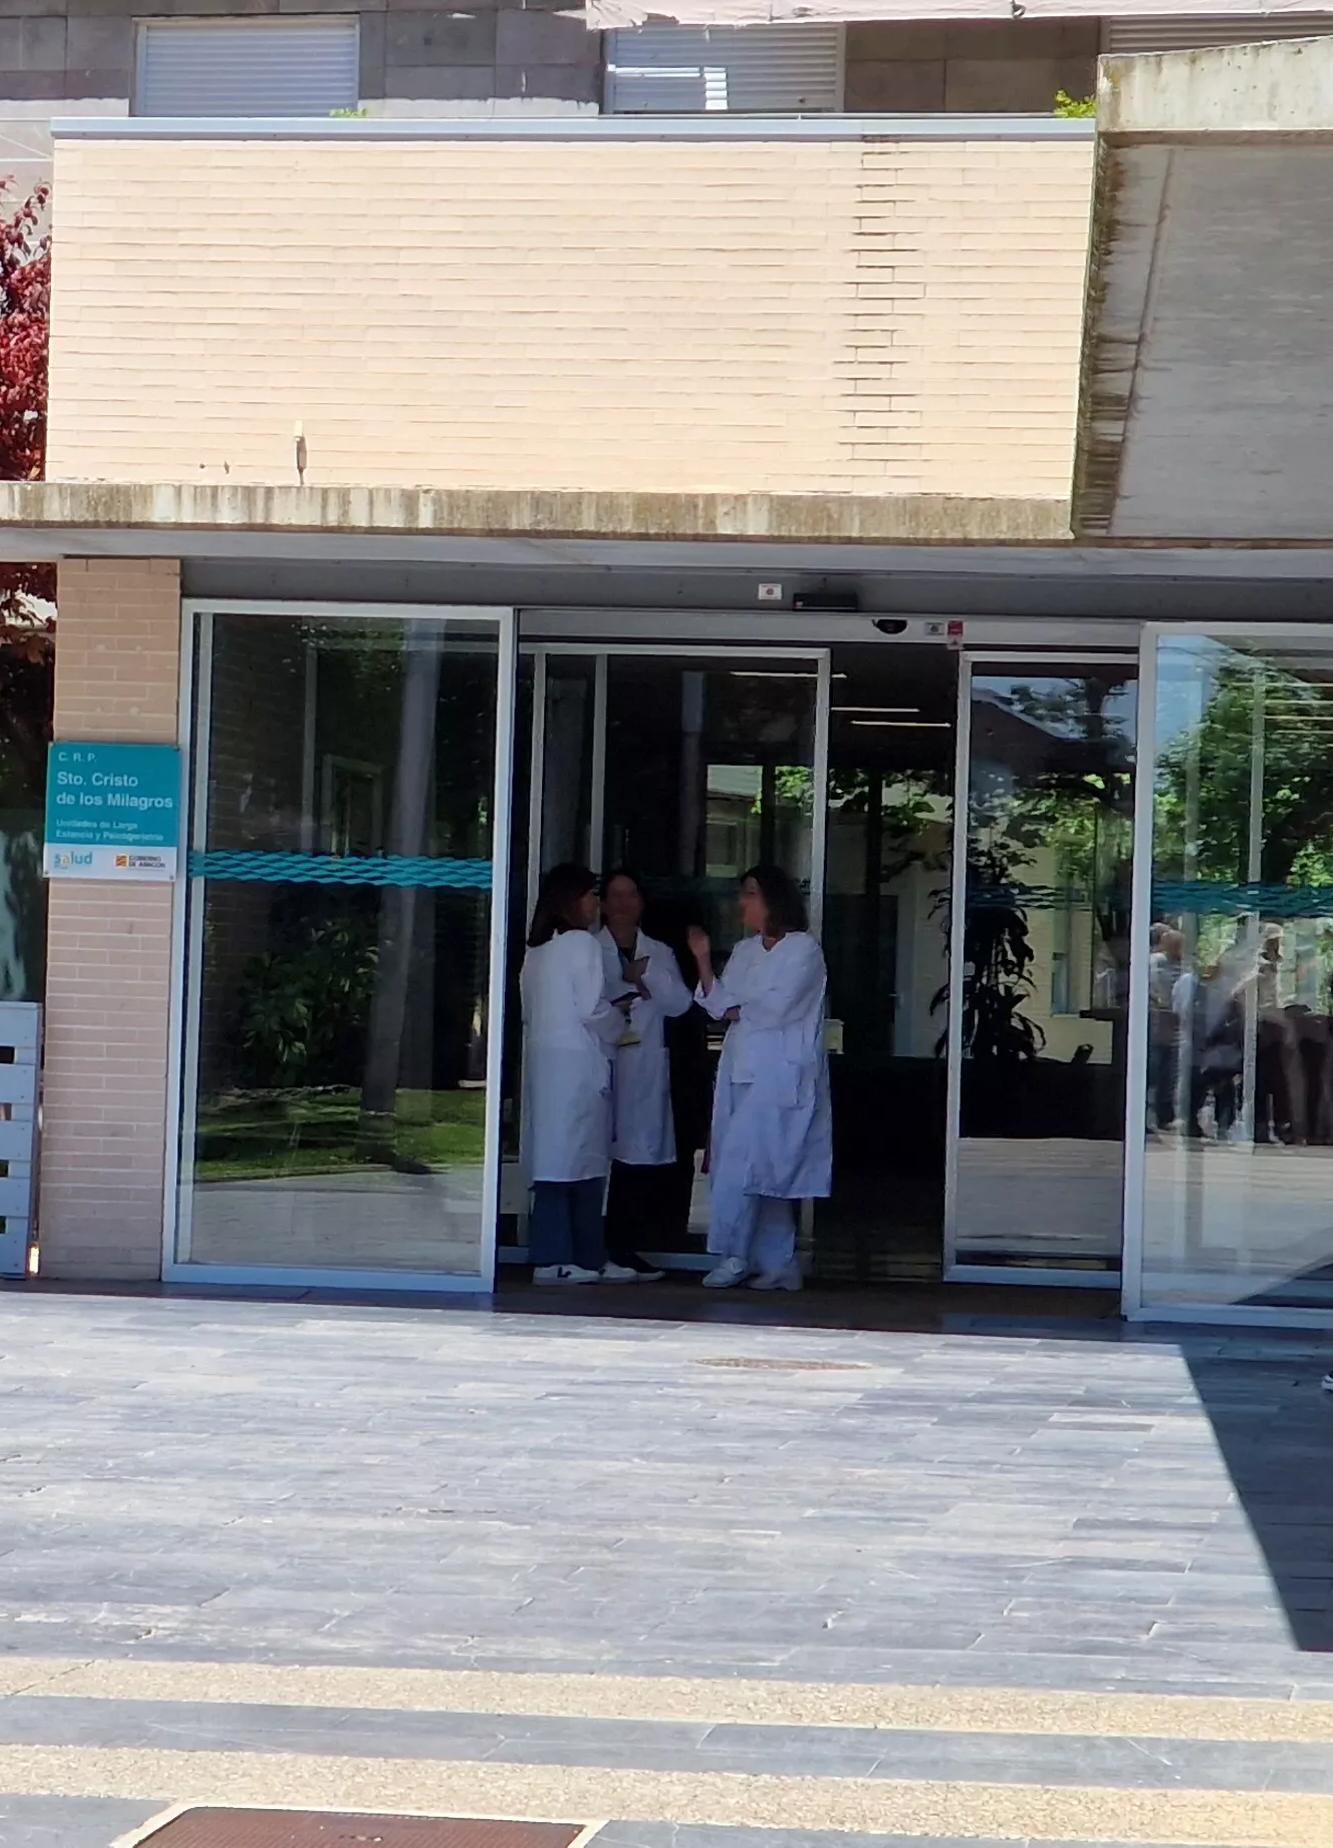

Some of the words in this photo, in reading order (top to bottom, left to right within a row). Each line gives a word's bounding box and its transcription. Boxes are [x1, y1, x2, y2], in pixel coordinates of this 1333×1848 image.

[57, 771, 87, 786] Sto.
[92, 772, 138, 787] Cristo
[56, 792, 75, 805] de
[80, 792, 103, 805] los
[107, 793, 173, 811] Milagros
[56, 818, 97, 828] Unidades
[113, 821, 138, 831] Larga
[95, 832, 102, 842] y
[54, 850, 93, 865] salud
